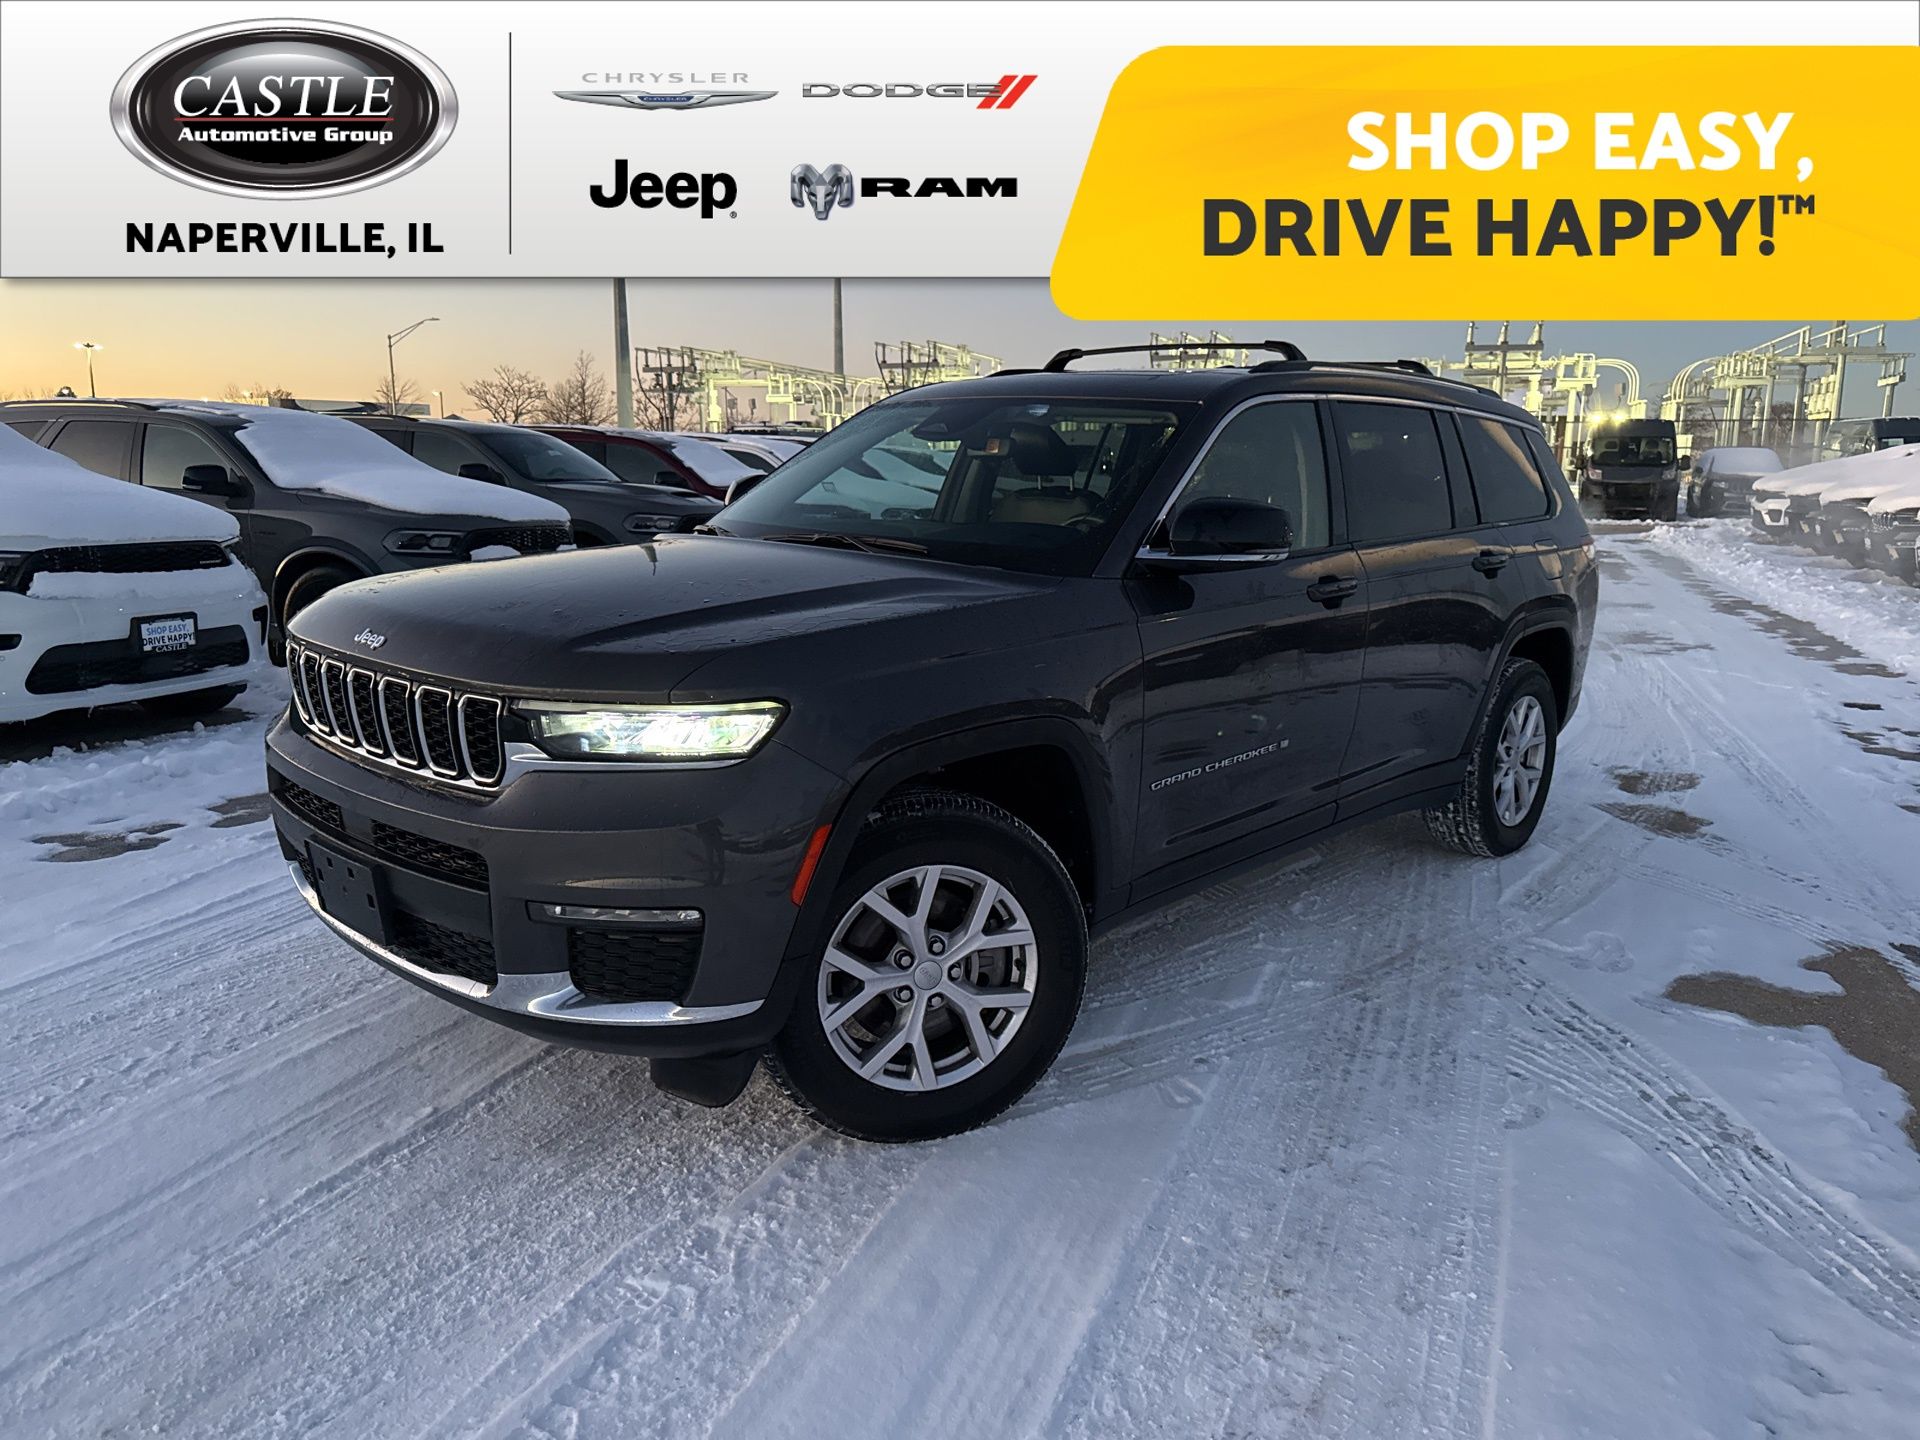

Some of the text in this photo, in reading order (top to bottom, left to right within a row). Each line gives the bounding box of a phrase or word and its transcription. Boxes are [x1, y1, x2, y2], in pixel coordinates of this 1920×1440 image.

[146, 626, 167, 636] SHOP
[143, 635, 166, 646] DRIVE
[354, 627, 385, 649] Jeep
[155, 643, 188, 653] CASTLE
[1150, 742, 1278, 791] GRAND CHEROKEE
